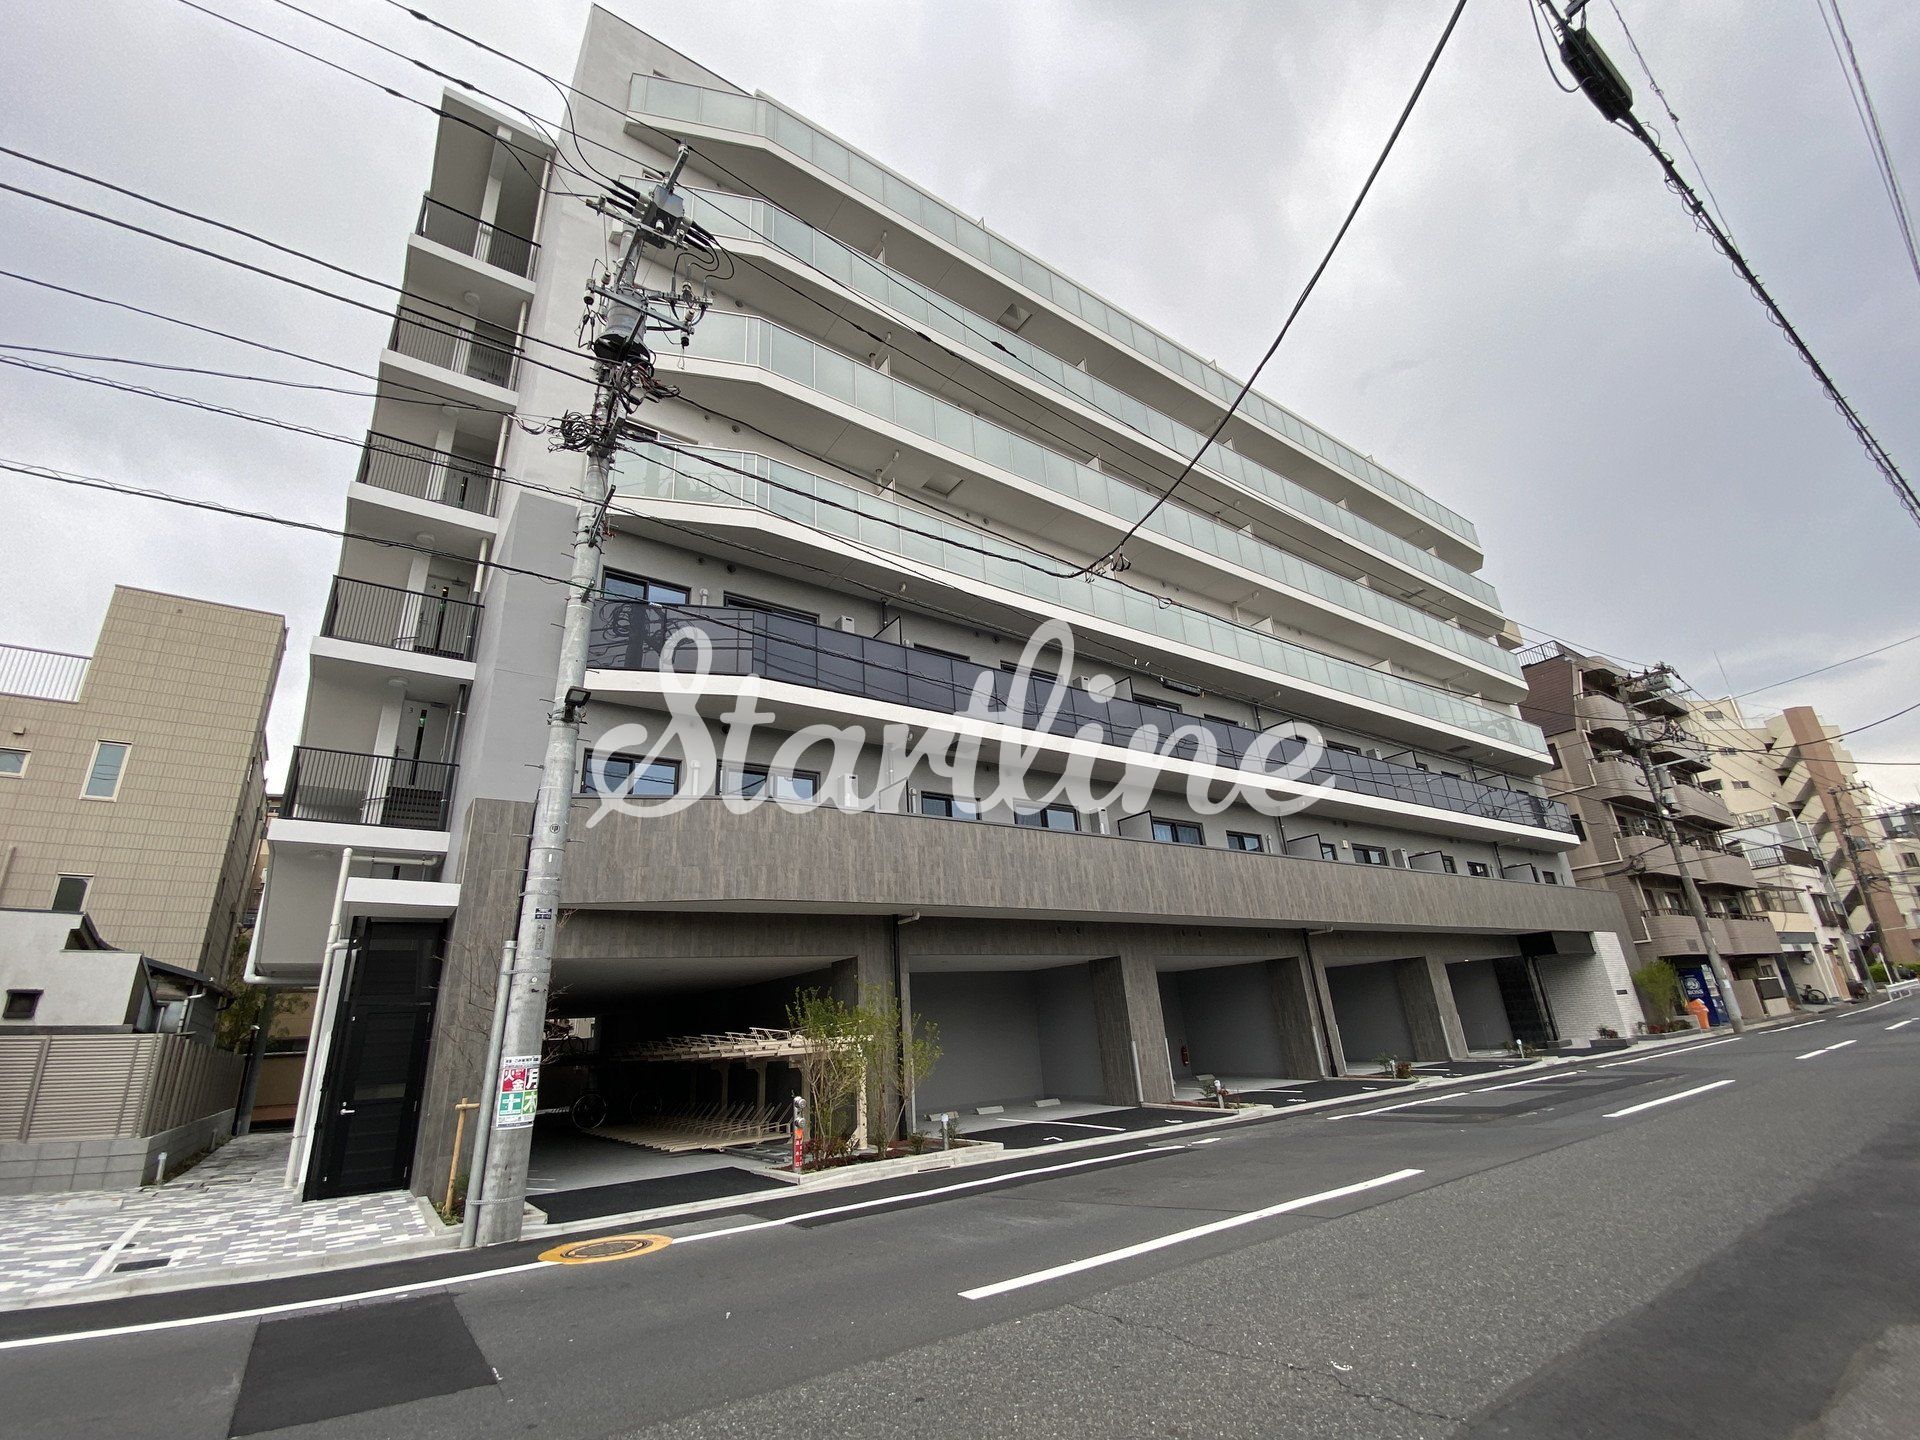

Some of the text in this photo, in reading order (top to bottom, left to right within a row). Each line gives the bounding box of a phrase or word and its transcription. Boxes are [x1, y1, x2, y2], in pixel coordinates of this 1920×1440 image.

[512, 1079, 524, 1091] 金
[526, 1068, 538, 1090] 月
[502, 1093, 521, 1112] 土
